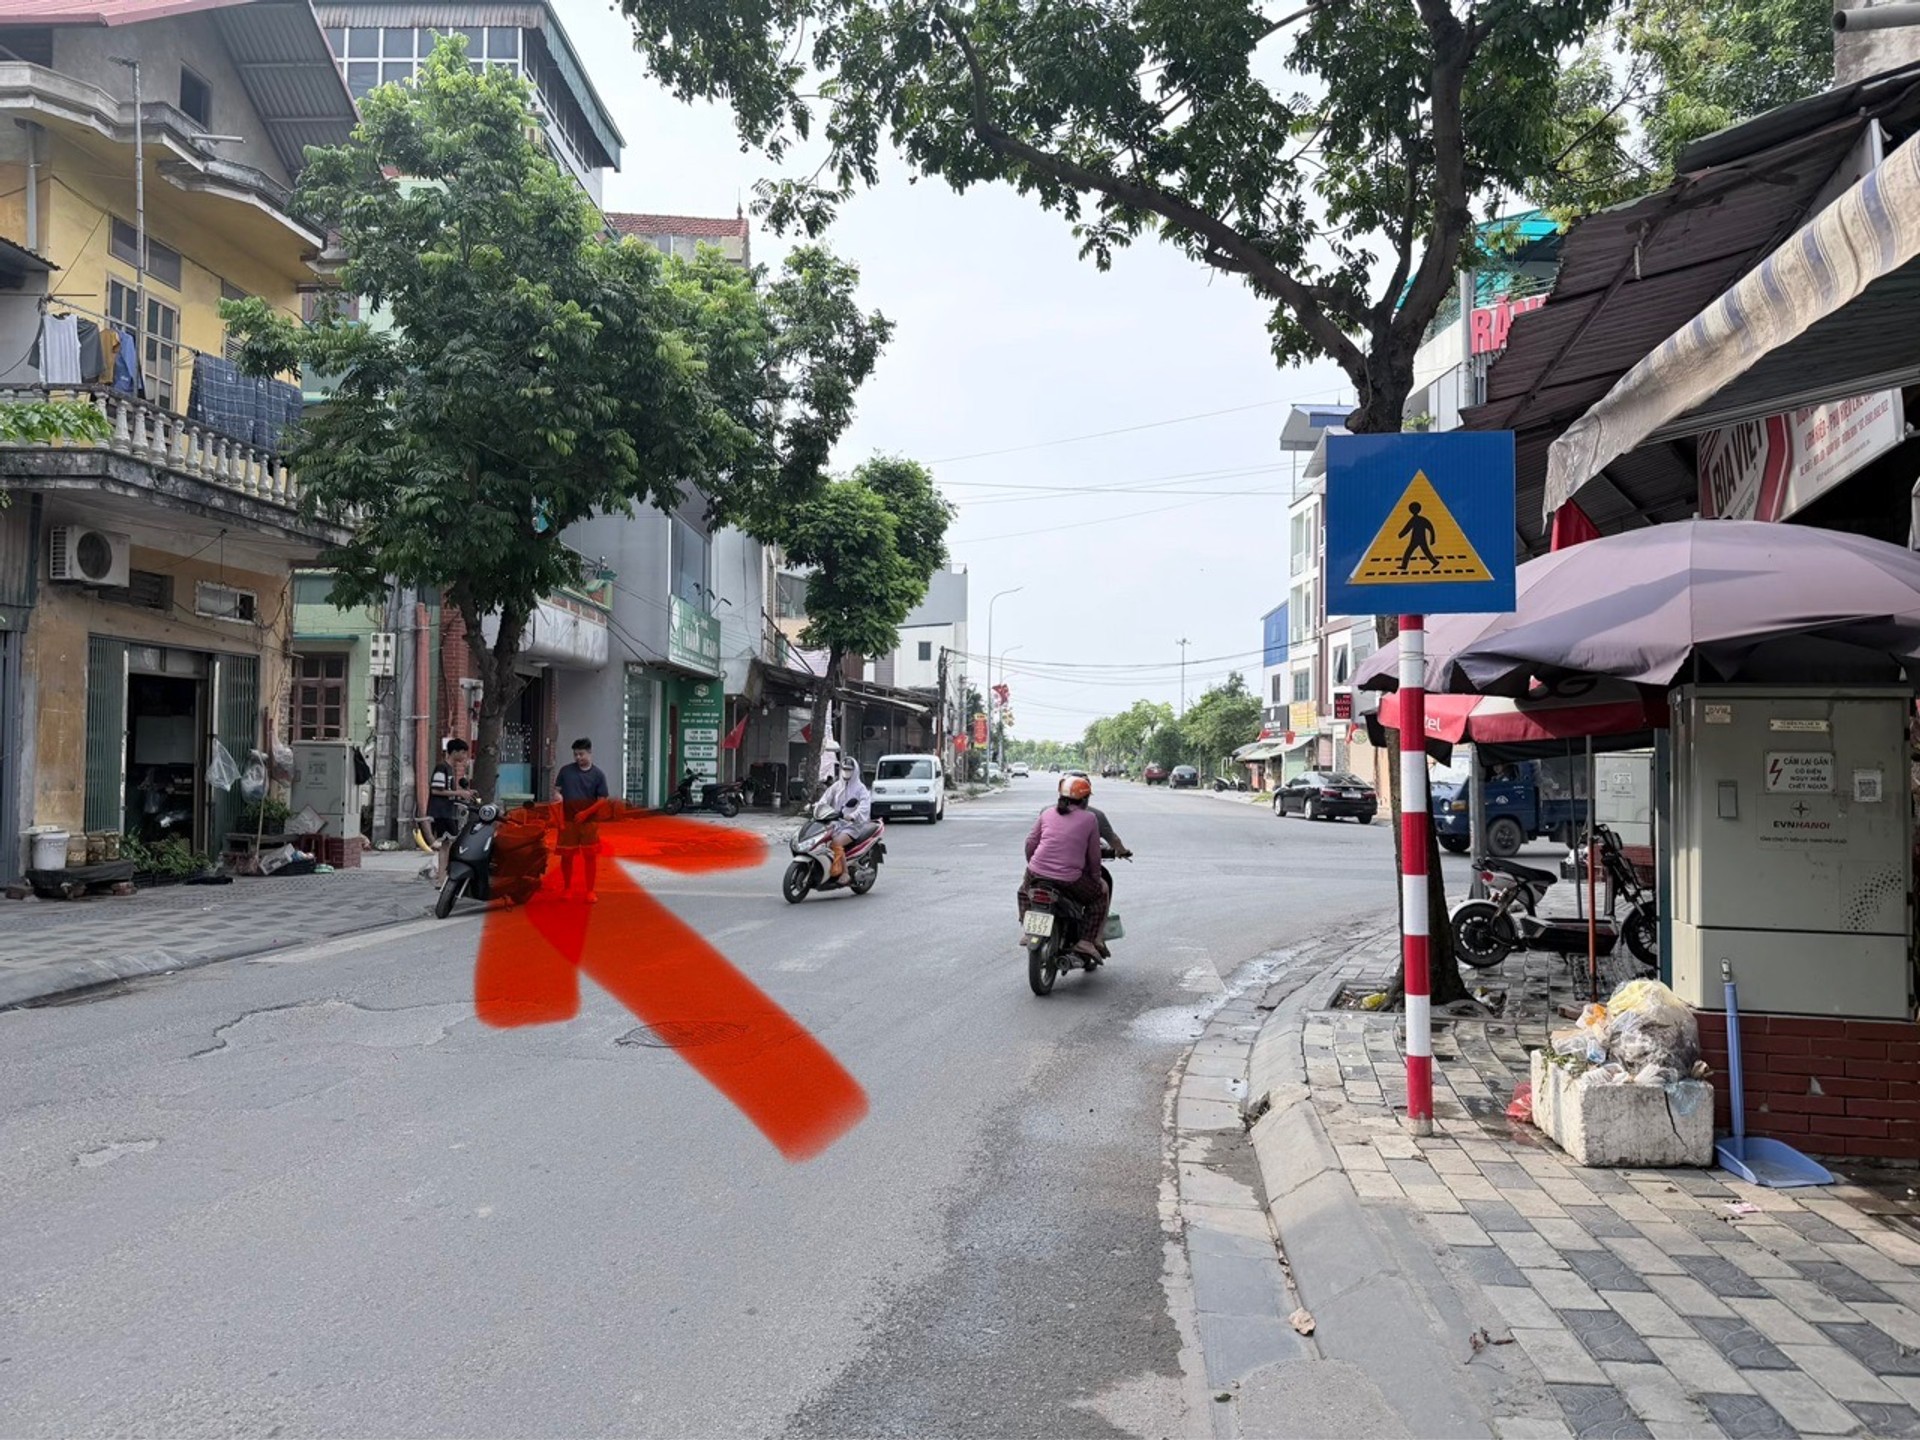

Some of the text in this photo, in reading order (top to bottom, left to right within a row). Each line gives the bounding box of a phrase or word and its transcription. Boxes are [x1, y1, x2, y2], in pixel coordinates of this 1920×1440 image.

[1713, 443, 1737, 517] BIA
[1783, 756, 1799, 766] CẤM
[1800, 758, 1812, 768] LẠI
[1813, 756, 1829, 766] GẦN
[1790, 775, 1809, 783] NGUY
[1773, 820, 1831, 830] EVNHANOI
